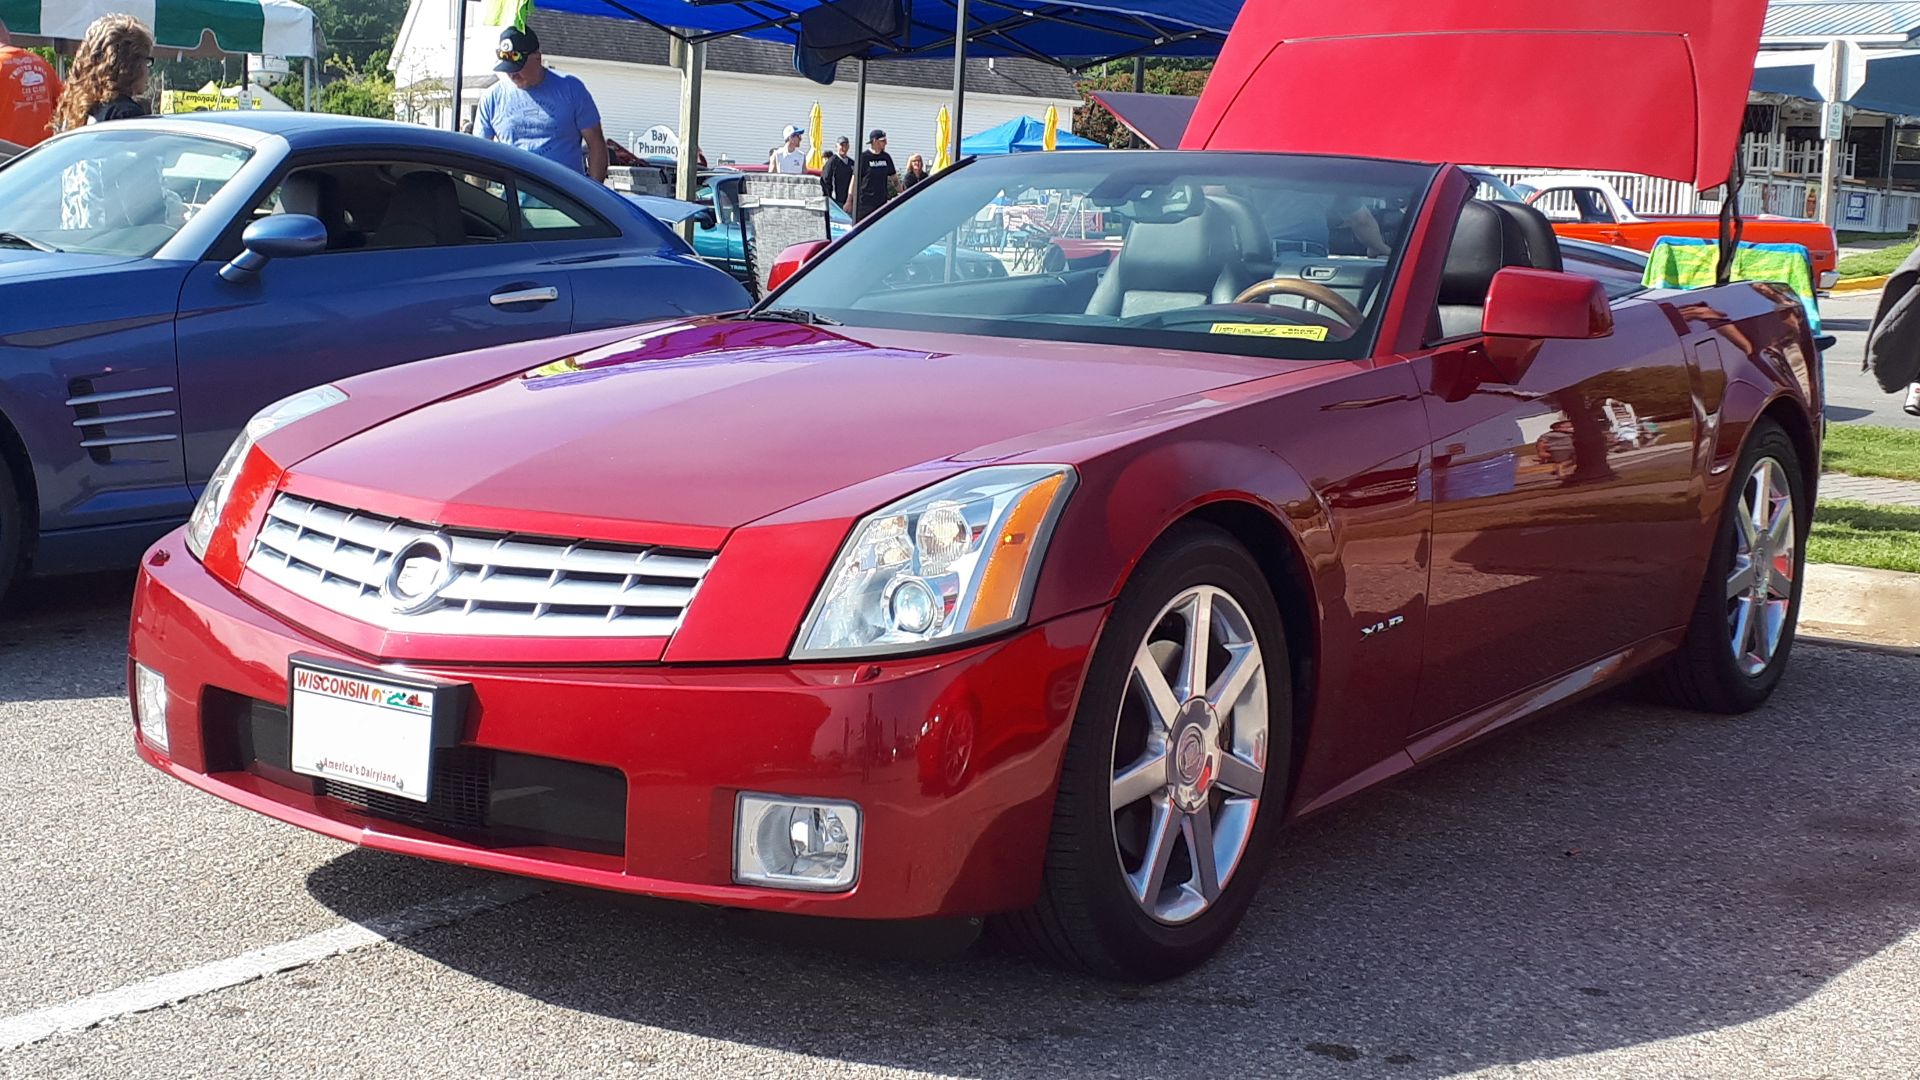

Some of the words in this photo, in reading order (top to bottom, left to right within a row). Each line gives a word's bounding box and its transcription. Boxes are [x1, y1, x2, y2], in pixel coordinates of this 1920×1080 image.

[651, 129, 668, 144] Bay
[638, 142, 678, 157] Pharmacy
[1360, 615, 1404, 640] XLR
[297, 671, 369, 700] WISCONSIN
[323, 757, 360, 775] America's
[361, 766, 397, 783] Dairyland
